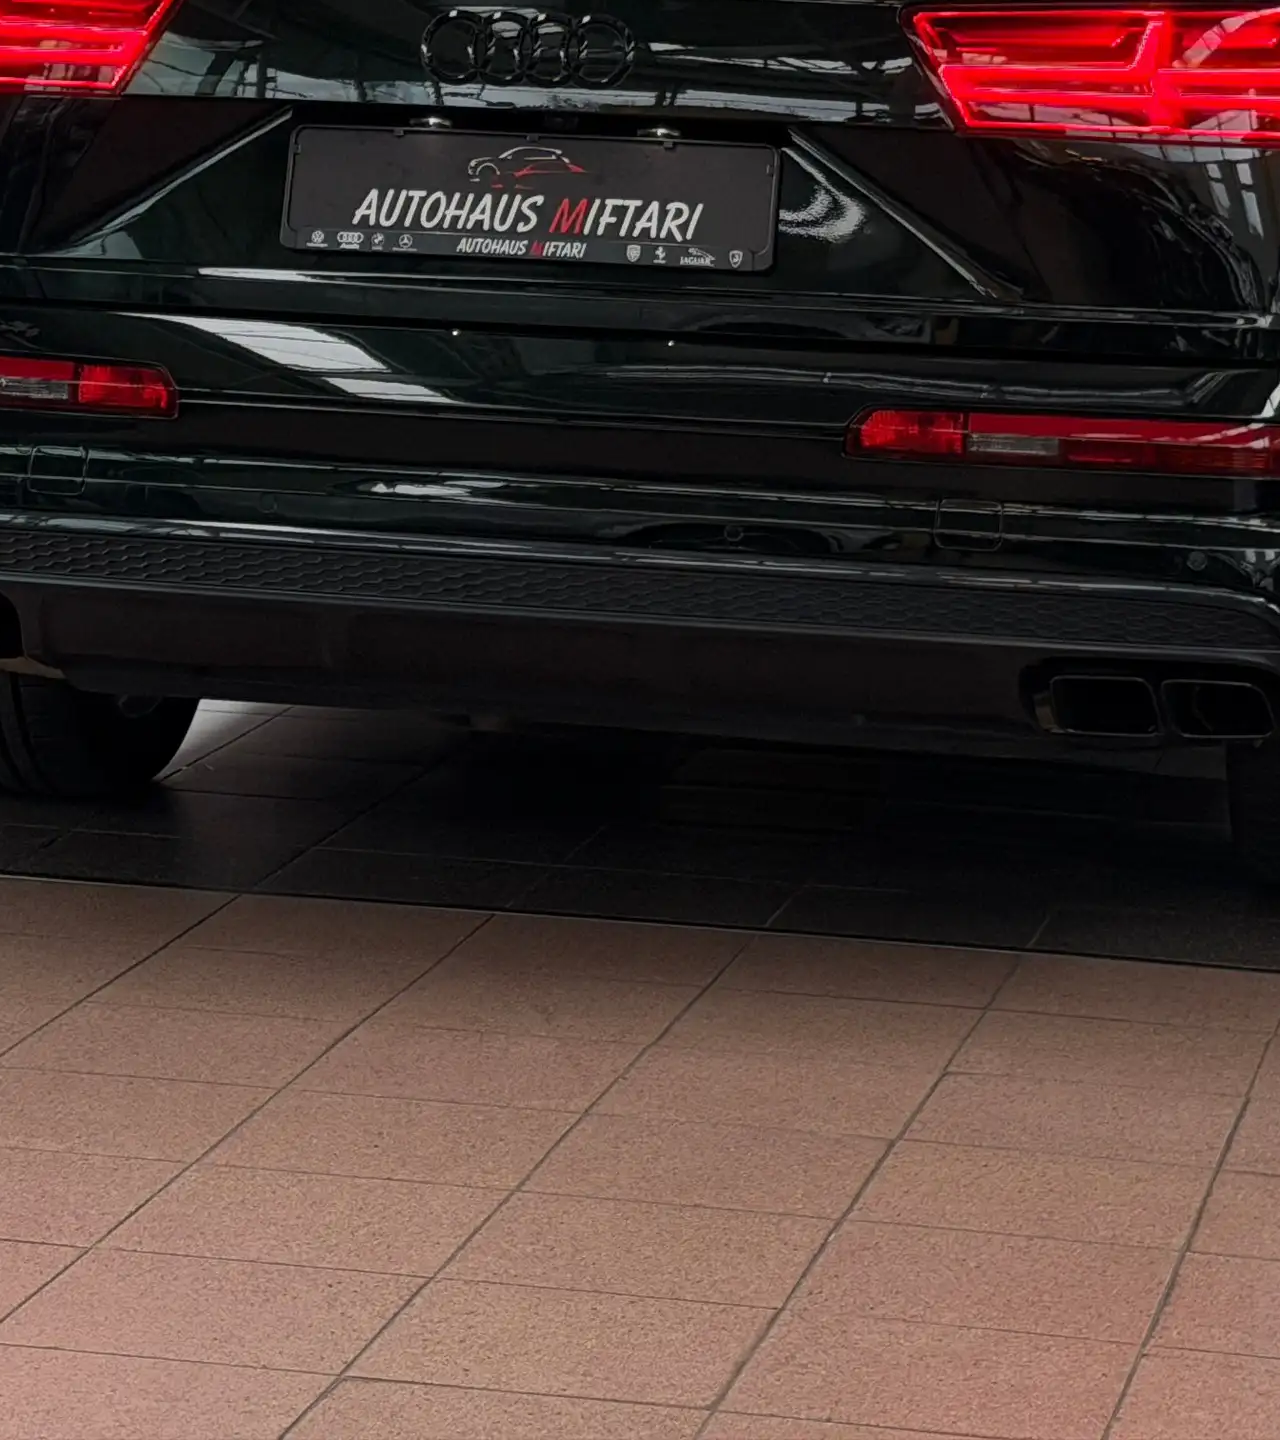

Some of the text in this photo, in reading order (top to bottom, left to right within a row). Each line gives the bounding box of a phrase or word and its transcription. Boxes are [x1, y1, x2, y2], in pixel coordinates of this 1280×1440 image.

[352, 188, 704, 242] AUTOHAUS MIFTARI
[456, 238, 587, 259] AUTOHAUS MIFTARI
